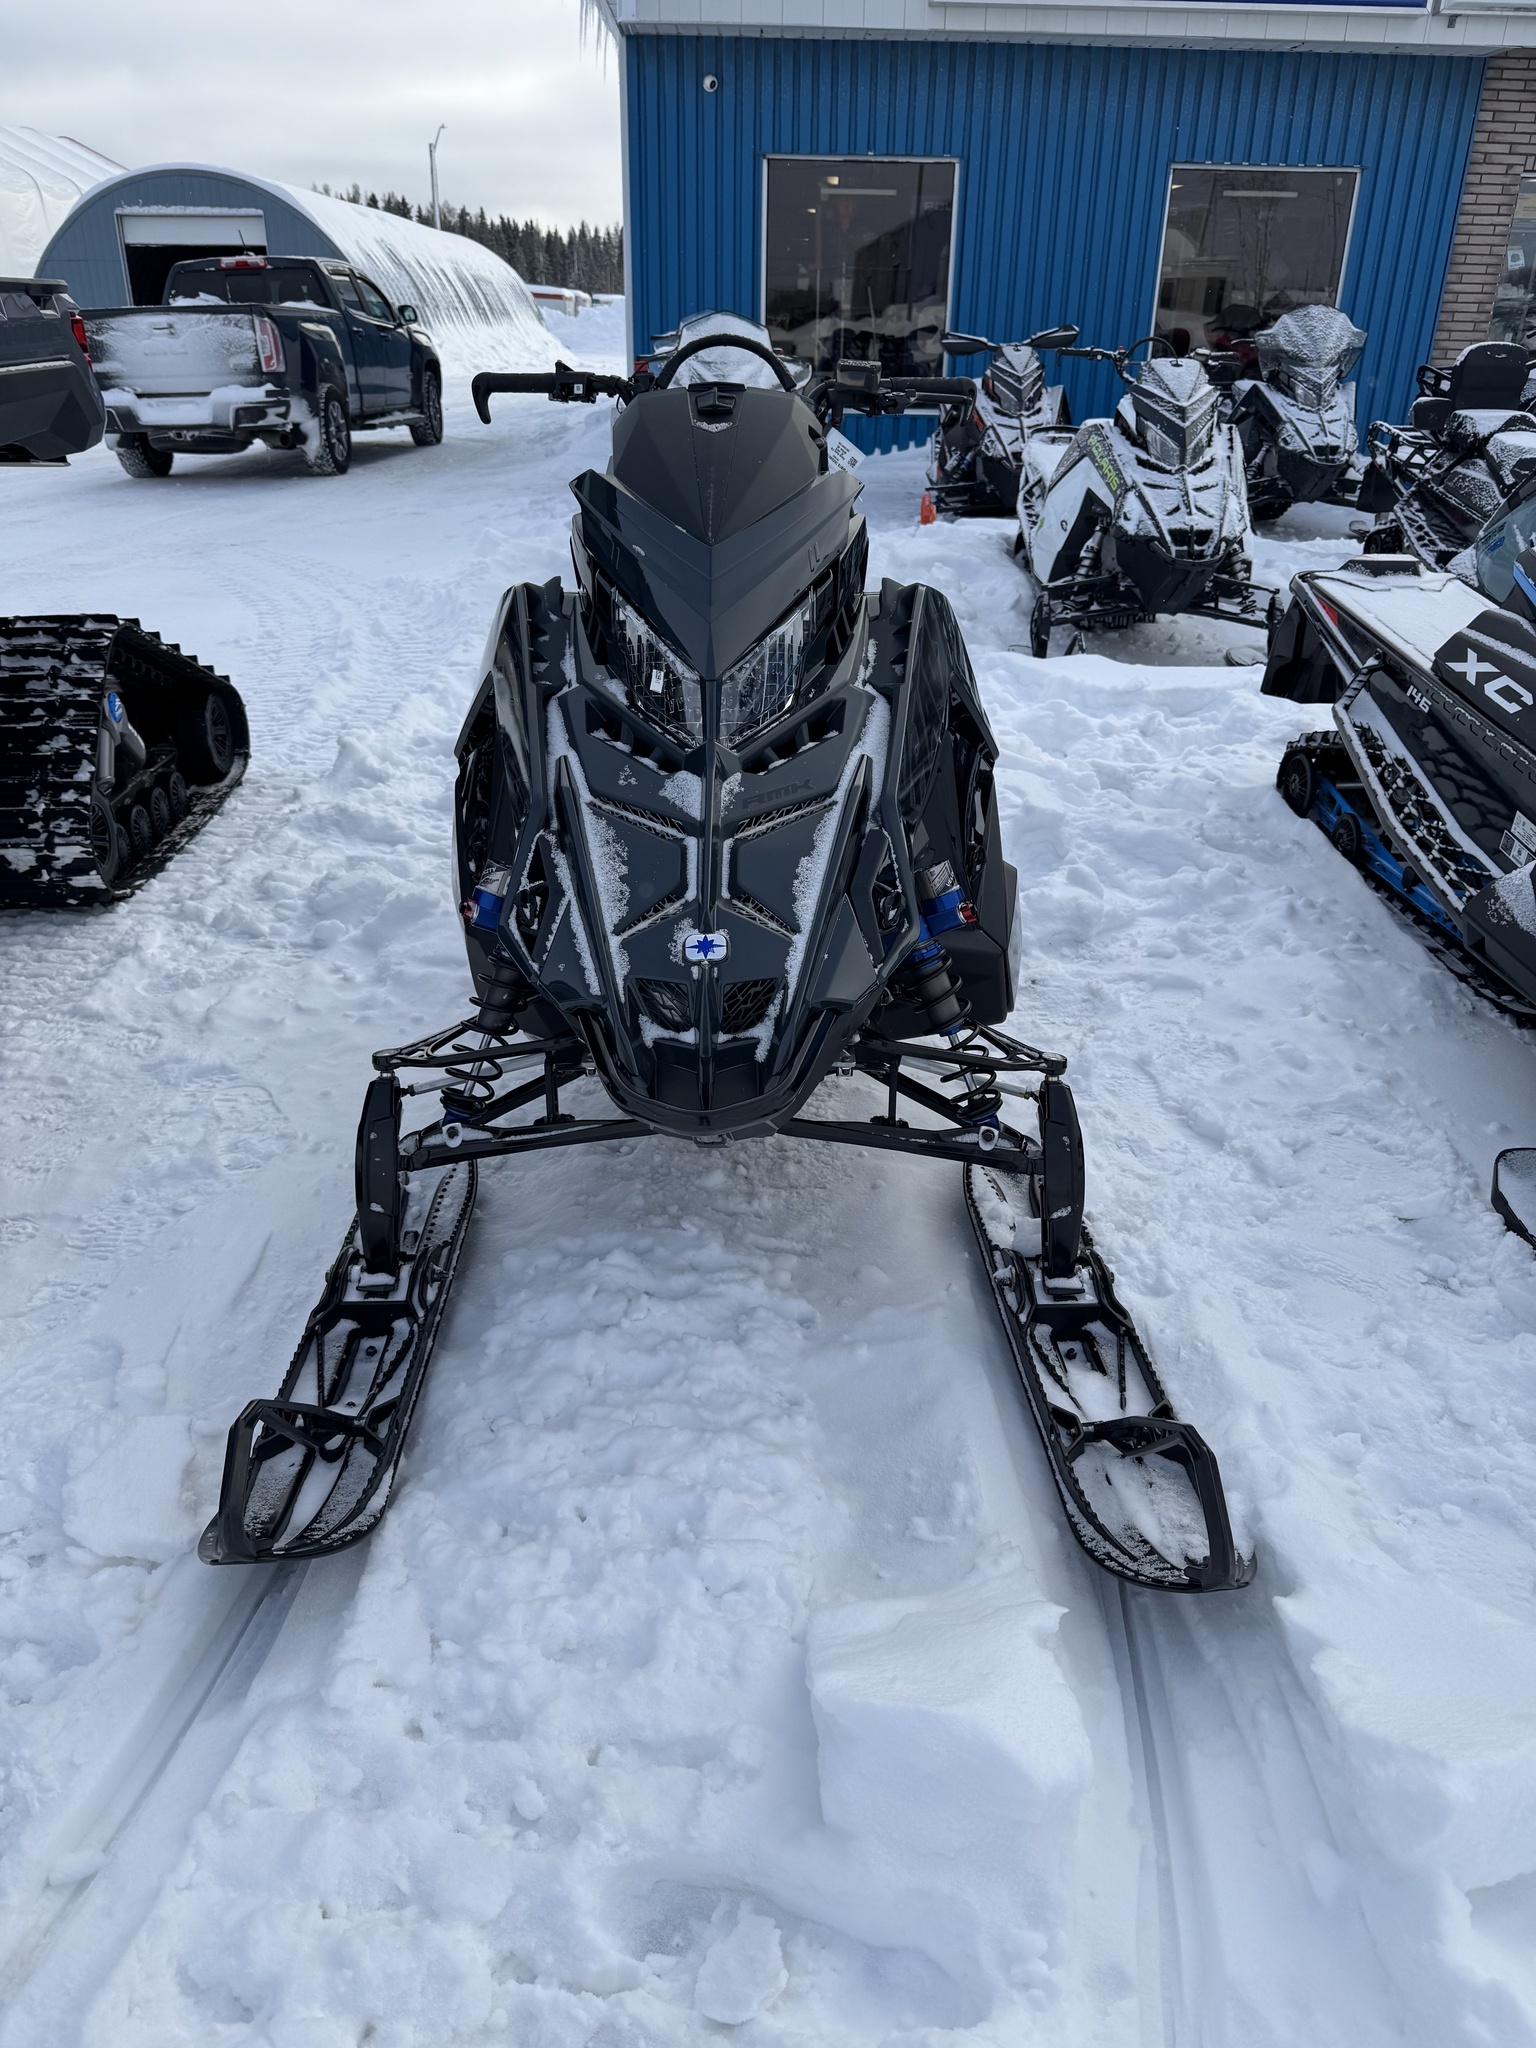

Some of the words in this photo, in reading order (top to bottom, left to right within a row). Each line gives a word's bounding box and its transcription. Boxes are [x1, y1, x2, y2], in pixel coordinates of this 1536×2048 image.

[1088, 433, 1120, 491] POLARIS
[1406, 685, 1432, 713] 146
[1445, 647, 1534, 714] XC
[742, 778, 816, 810] RMK
